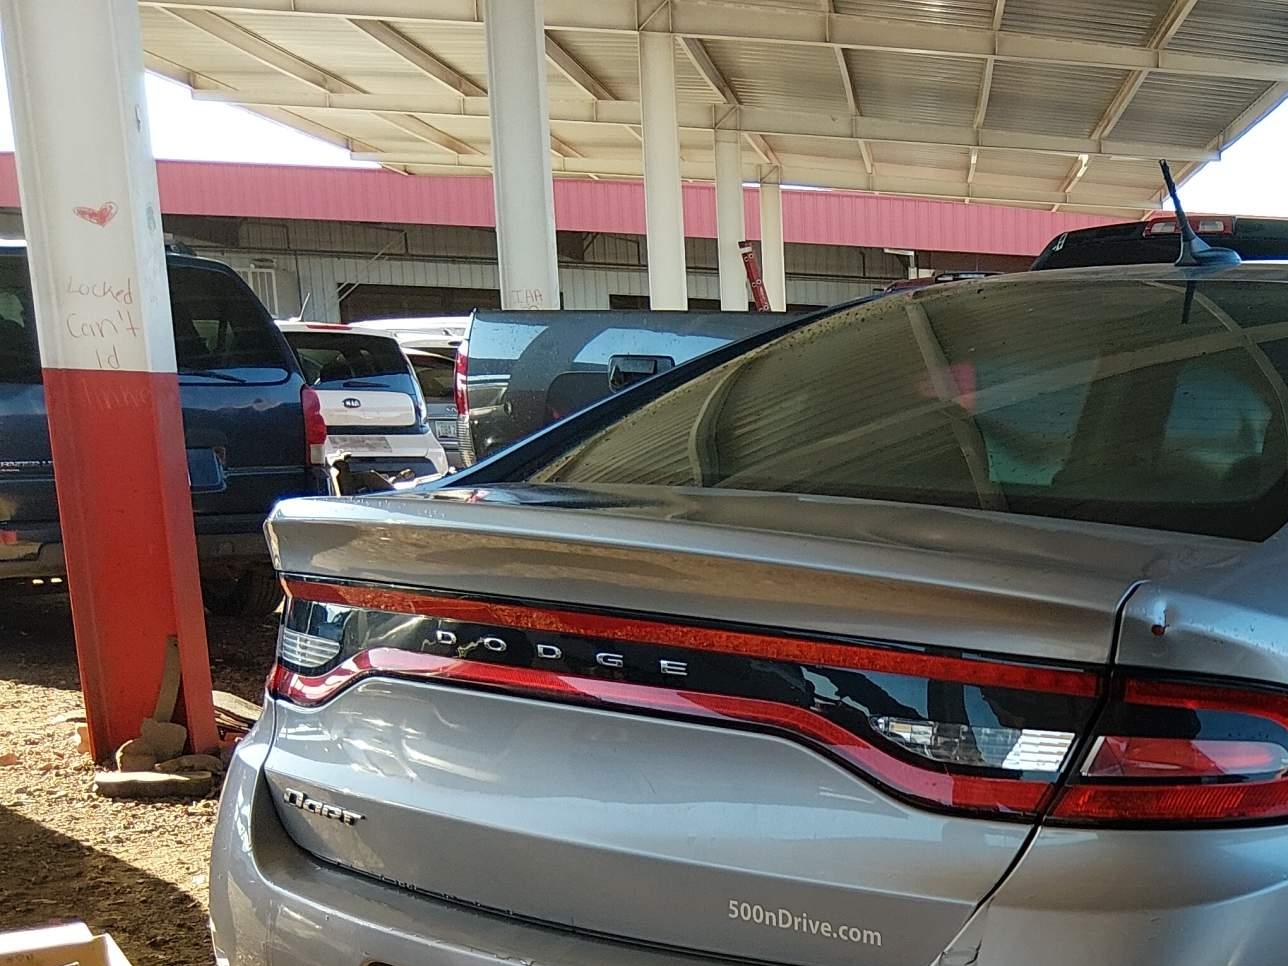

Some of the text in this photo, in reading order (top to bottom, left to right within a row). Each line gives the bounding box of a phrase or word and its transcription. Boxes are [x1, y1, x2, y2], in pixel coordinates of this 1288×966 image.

[66, 310, 141, 339] Can't
[436, 629, 688, 676] DODGE
[728, 899, 882, 946] 500nDrive.com
